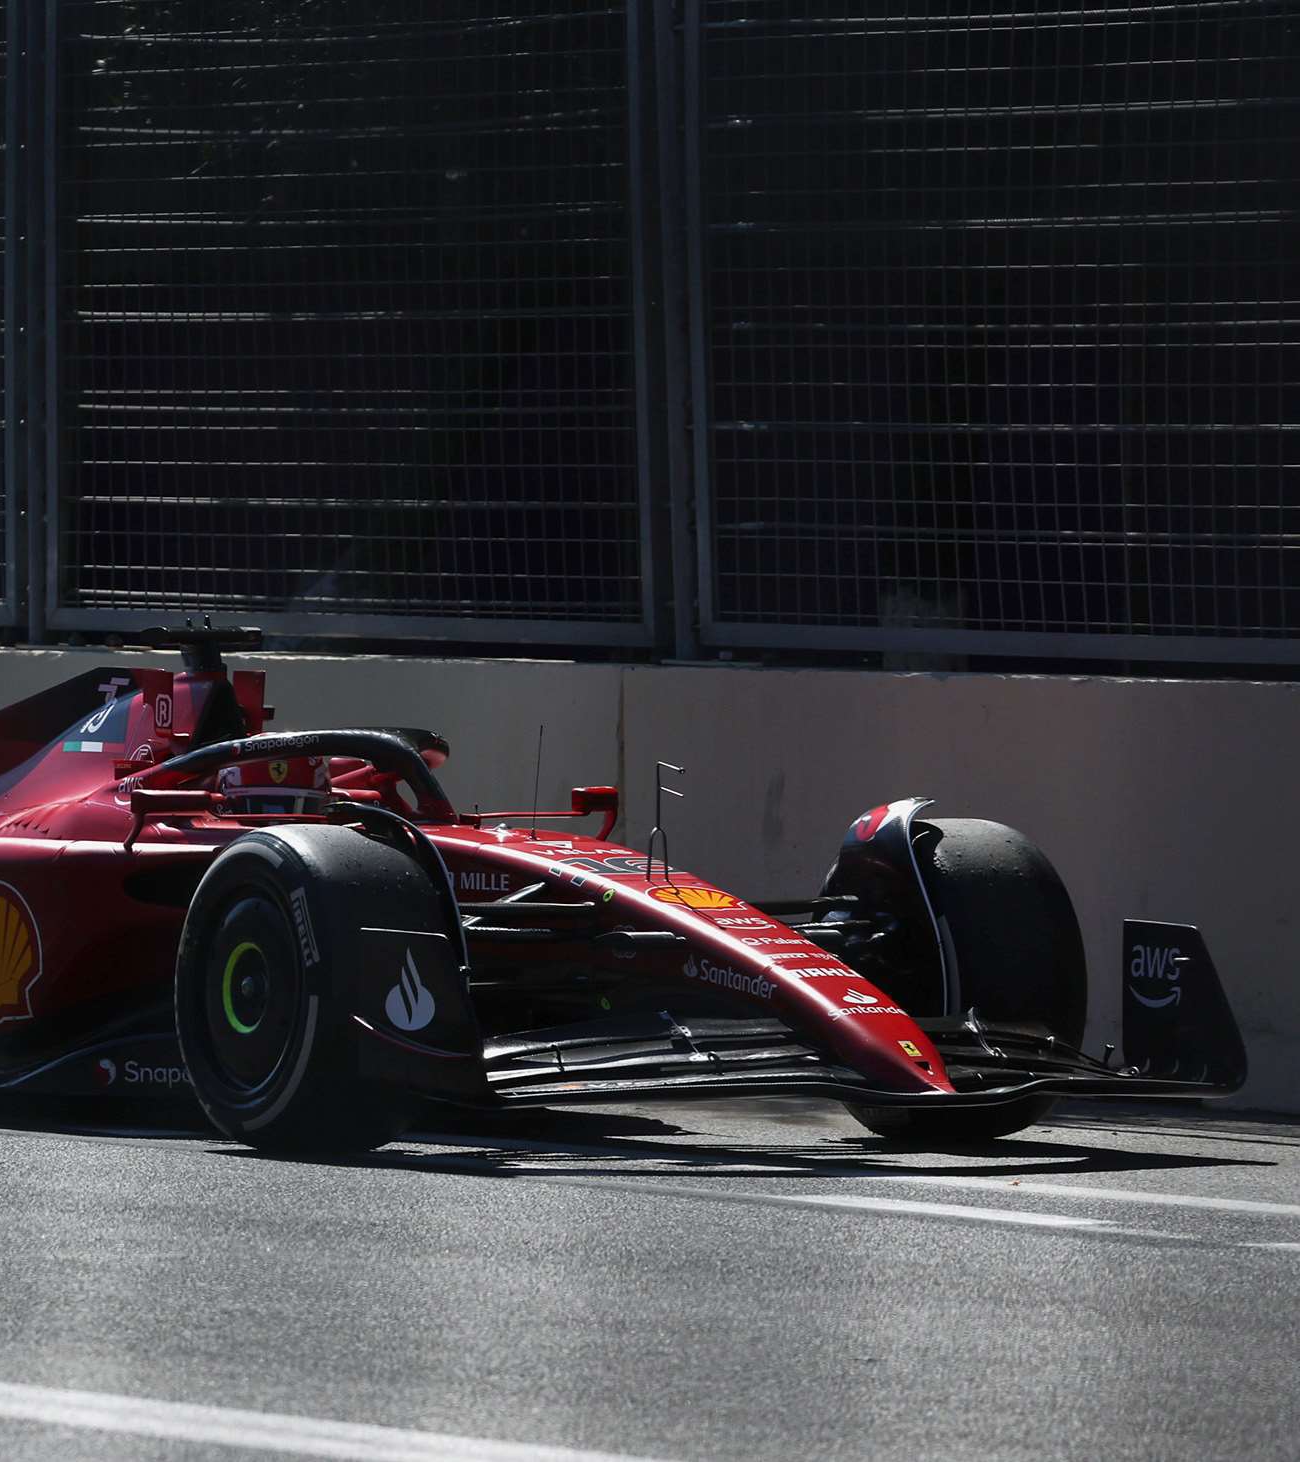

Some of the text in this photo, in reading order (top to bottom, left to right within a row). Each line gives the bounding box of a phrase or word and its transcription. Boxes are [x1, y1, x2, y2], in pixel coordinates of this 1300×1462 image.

[244, 734, 319, 752] Snapdragon
[460, 872, 509, 891] MILLE
[714, 917, 768, 926] aws
[758, 937, 816, 946] Palant
[1131, 944, 1181, 981] aws
[699, 959, 778, 1000] Santander
[786, 967, 865, 980] MAHL
[827, 1005, 910, 1021] Santand
